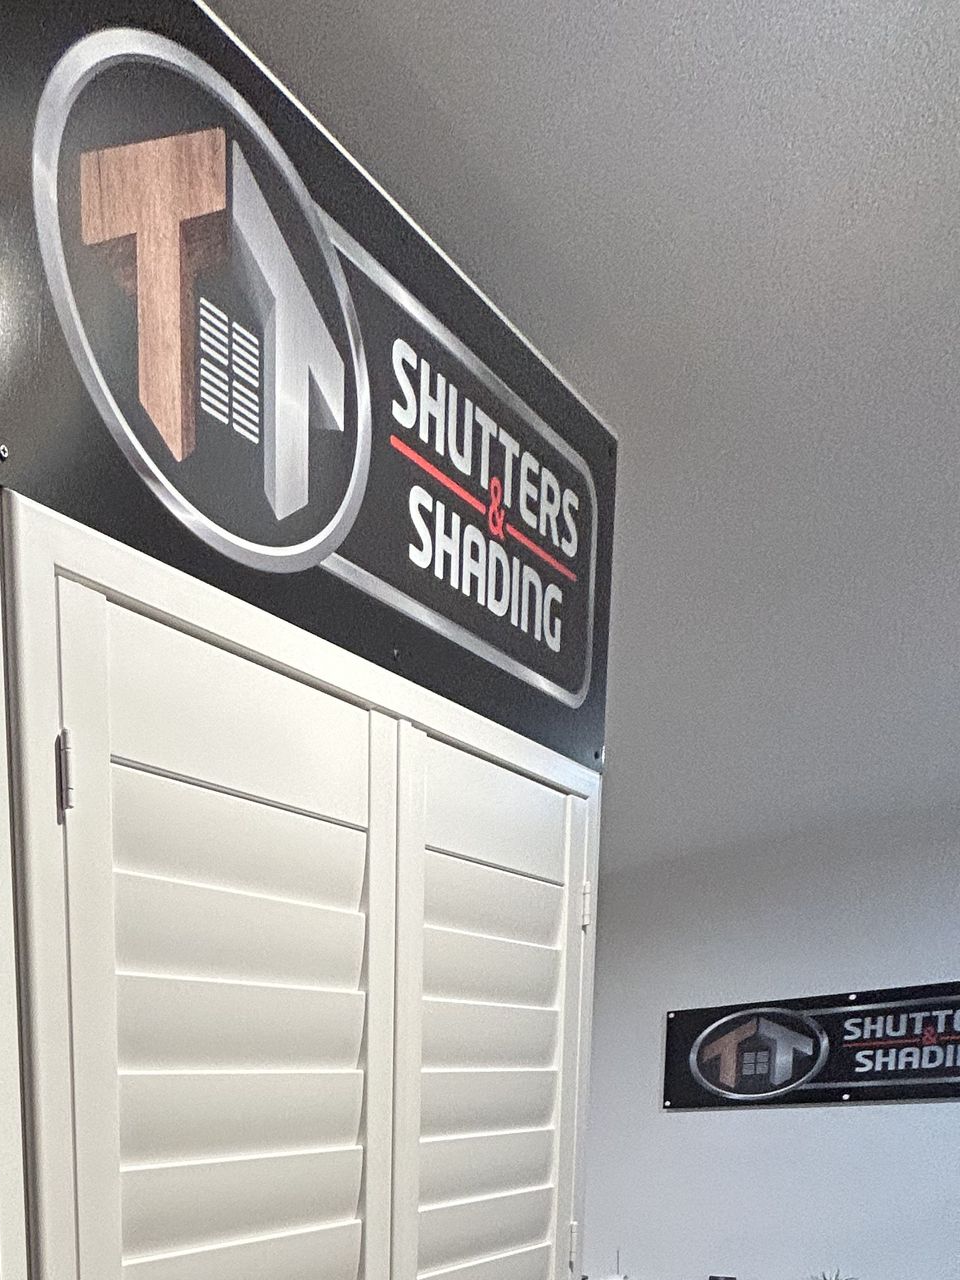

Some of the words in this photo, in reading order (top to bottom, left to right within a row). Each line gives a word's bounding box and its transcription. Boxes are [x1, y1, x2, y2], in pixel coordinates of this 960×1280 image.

[392, 338, 579, 558] SHUTTERS
[488, 476, 505, 541] &
[409, 485, 563, 653] SHADING
[855, 1044, 960, 1073] SHADI
